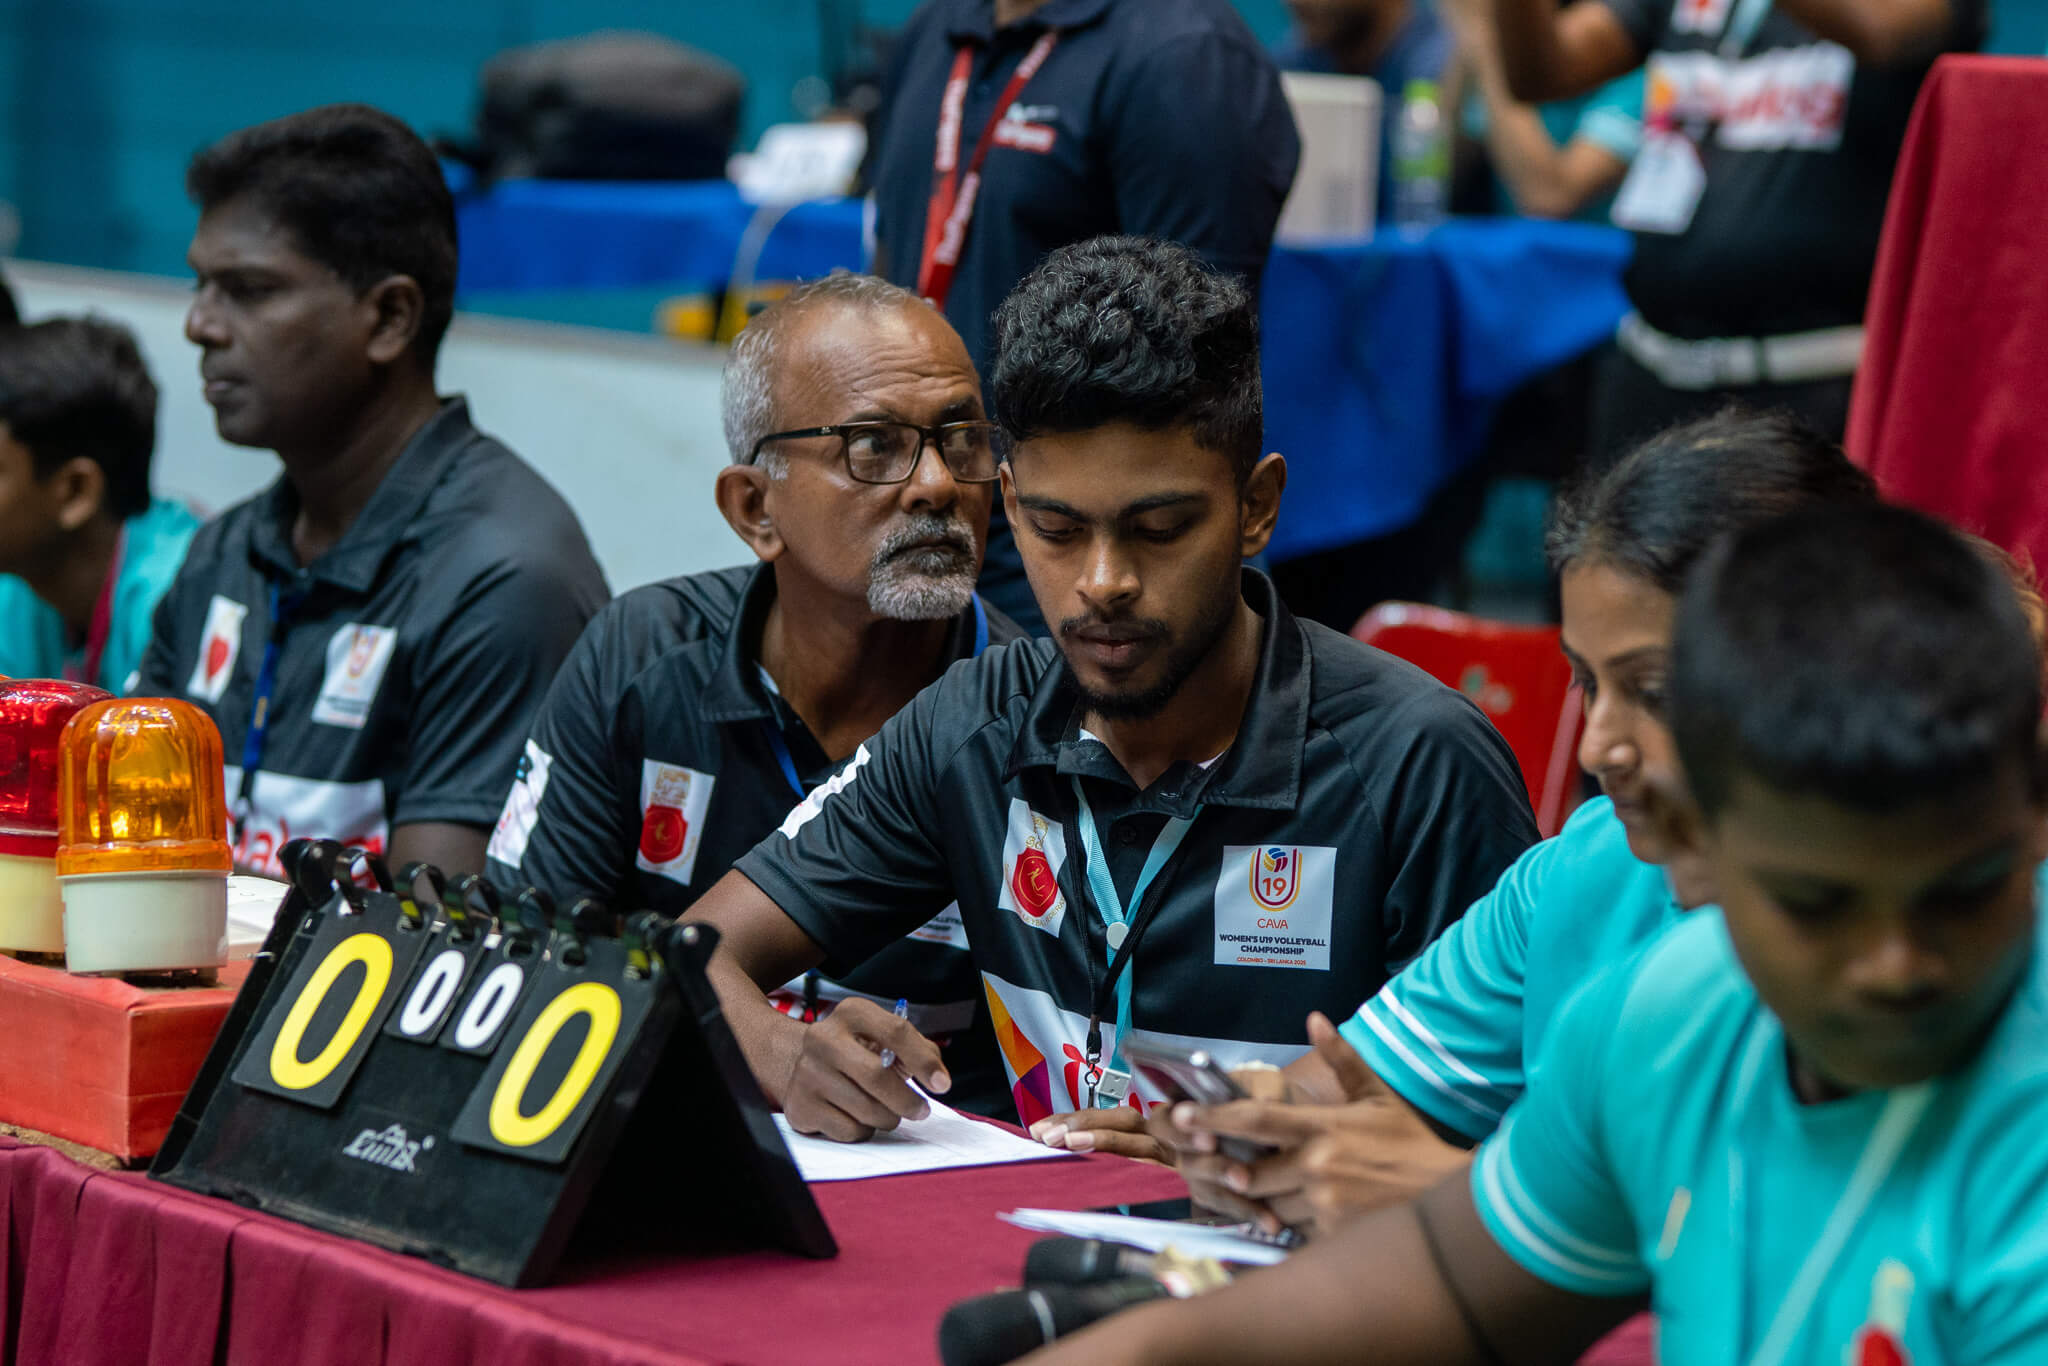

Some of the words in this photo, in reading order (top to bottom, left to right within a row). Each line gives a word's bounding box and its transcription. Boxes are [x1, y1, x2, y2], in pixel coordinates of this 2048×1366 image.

[1262, 877, 1287, 897] 19
[1219, 934, 1258, 943] WOMEN'S
[1259, 935, 1273, 944] U19
[1274, 936, 1327, 947] VOLLEYBALL
[1240, 944, 1305, 955] CHAMPIONSHIP
[1256, 918, 1289, 930] CAVA
[270, 932, 393, 1090] 0
[399, 949, 465, 1036] 0
[455, 962, 524, 1049] 0
[488, 981, 623, 1147] 0
